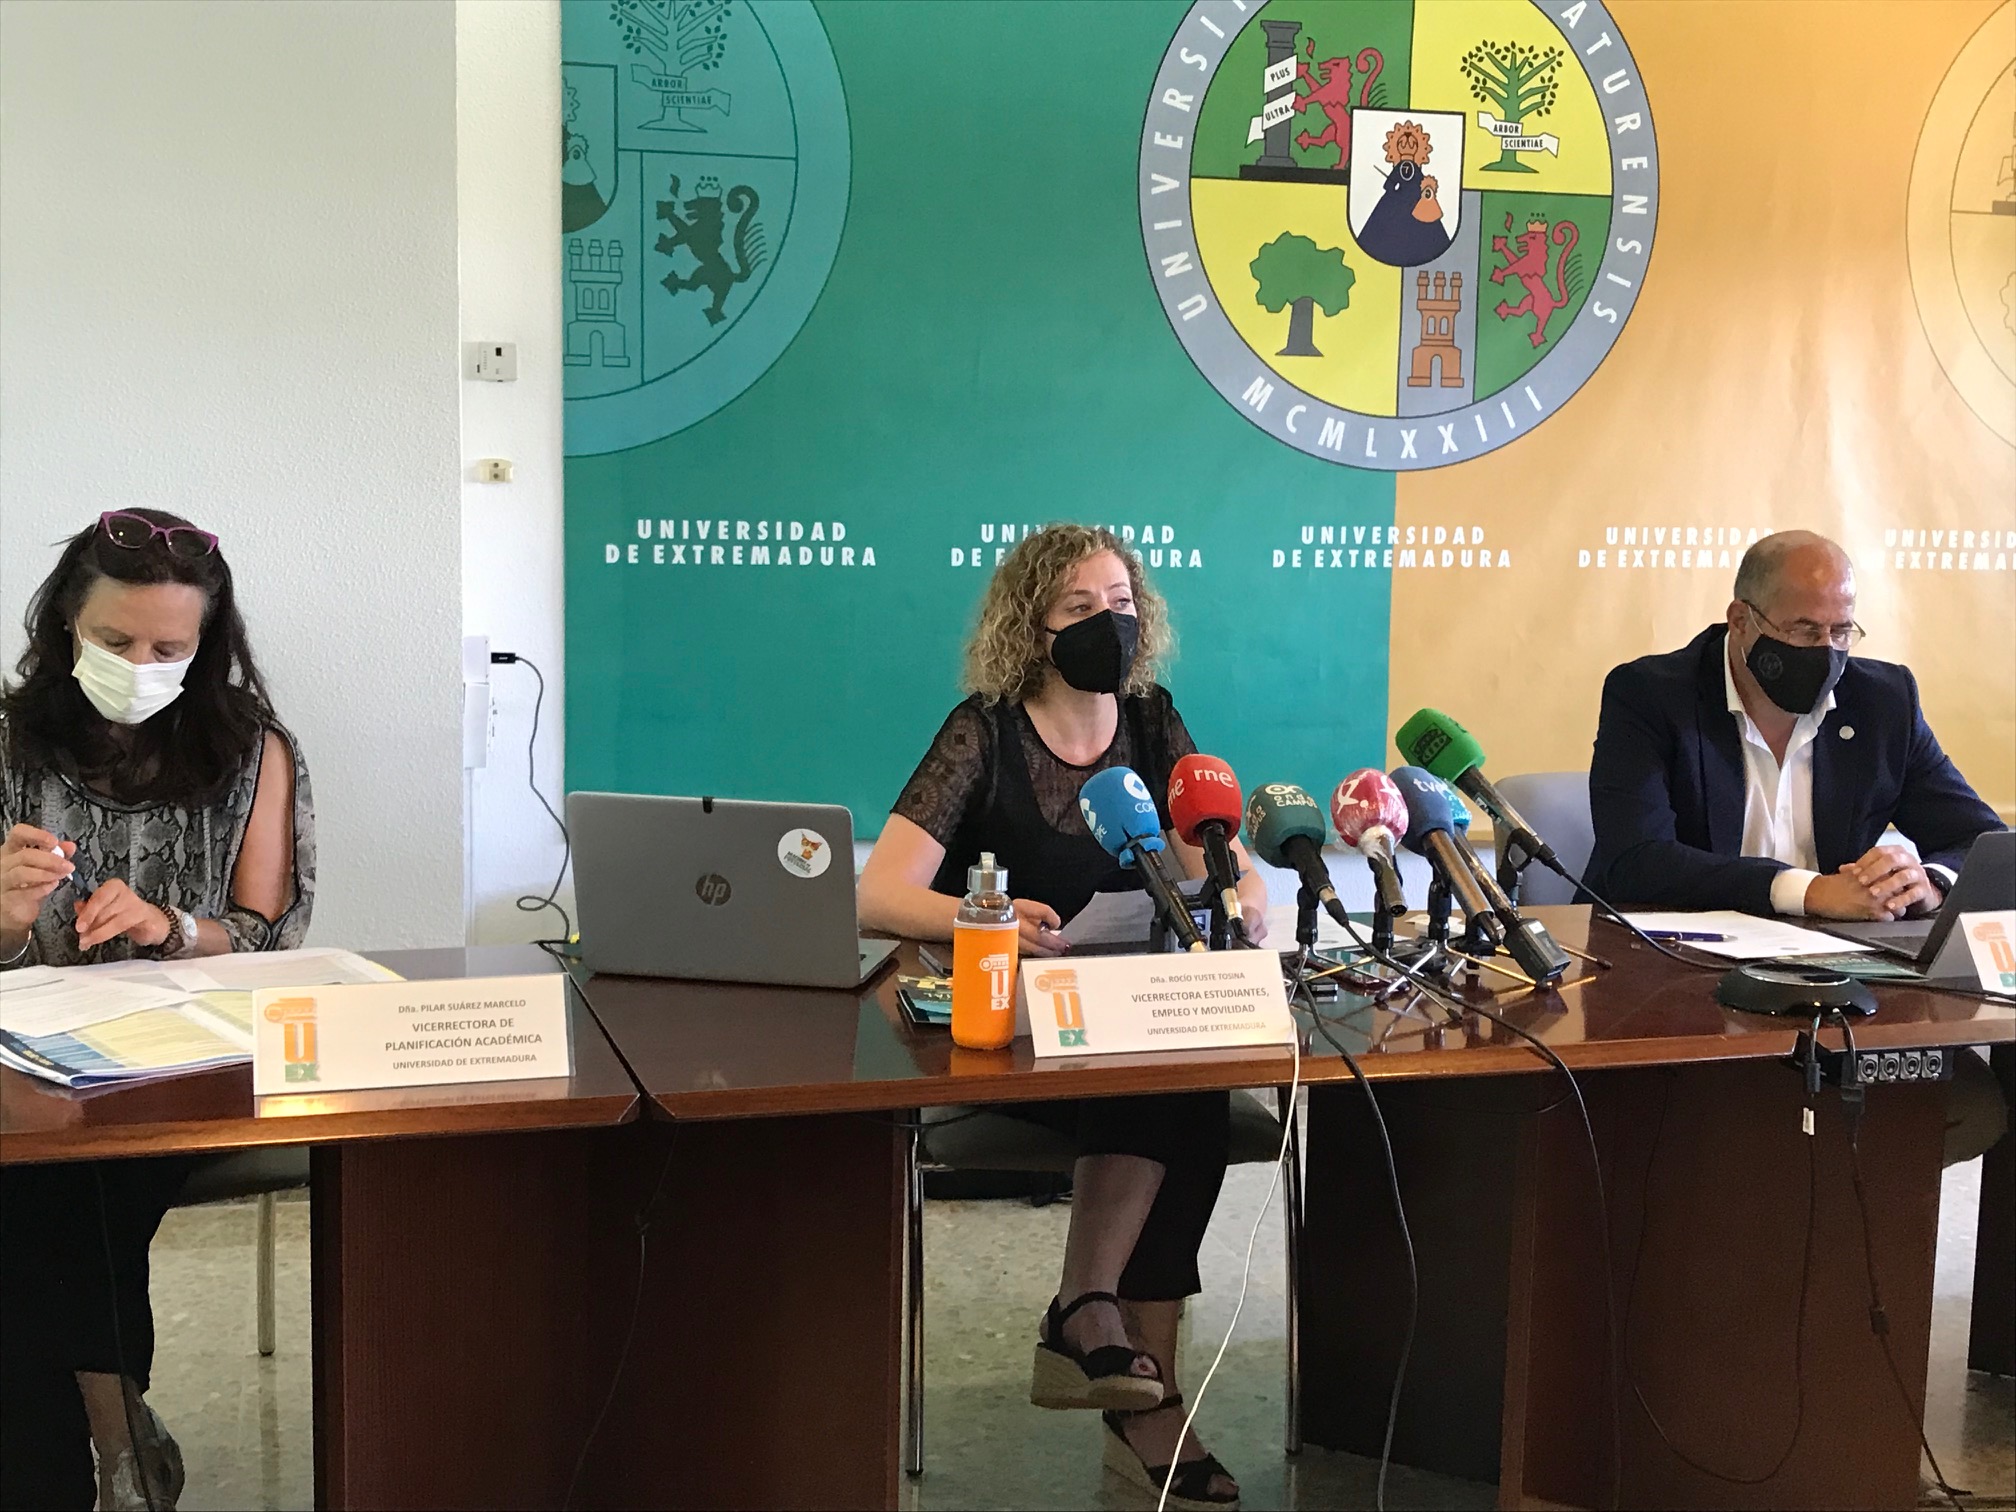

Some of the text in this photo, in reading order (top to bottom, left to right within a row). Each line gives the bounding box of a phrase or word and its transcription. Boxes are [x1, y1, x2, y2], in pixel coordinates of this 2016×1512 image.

[1270, 67, 1291, 82] PLUS
[652, 78, 683, 89] ARBOR
[665, 95, 712, 105] SCIENTIAE
[1265, 104, 1290, 121] ULTRA
[1493, 123, 1520, 134] ARBOR
[1504, 139, 1544, 148] SCIENTIAE
[1242, 376, 1542, 459] MCMLXXIII
[637, 519, 847, 541] UNIVERSIDAD
[1301, 526, 1485, 545] UNIVERSIDAD
[605, 544, 877, 567] DE EXTREMADURA
[951, 547, 982, 567] DE
[1272, 549, 1511, 568] DE EXTREMADURA
[1577, 549, 1607, 568] DE
[1193, 769, 1234, 788] rne
[701, 875, 727, 905] hp
[1150, 972, 1245, 984] Dña. ROCÍO YUSTE TOSINA
[1131, 987, 1269, 1003] VICERRECTORA ESTUDIANTES,
[398, 999, 526, 1014] Dña. PILAR SUÁREZ MARCELO
[1152, 1004, 1256, 1018] EMPLEO Y MOVILIDAD
[412, 1017, 515, 1032] VICERRECTORA DE
[1147, 1021, 1267, 1036] UNIVERSIDAD DE EXTREMADURA
[385, 1033, 543, 1052] PLANIFICACIÓN ACADÉMICA
[393, 1053, 538, 1070] UNIVERSIDAD DE EXTREMADURA
